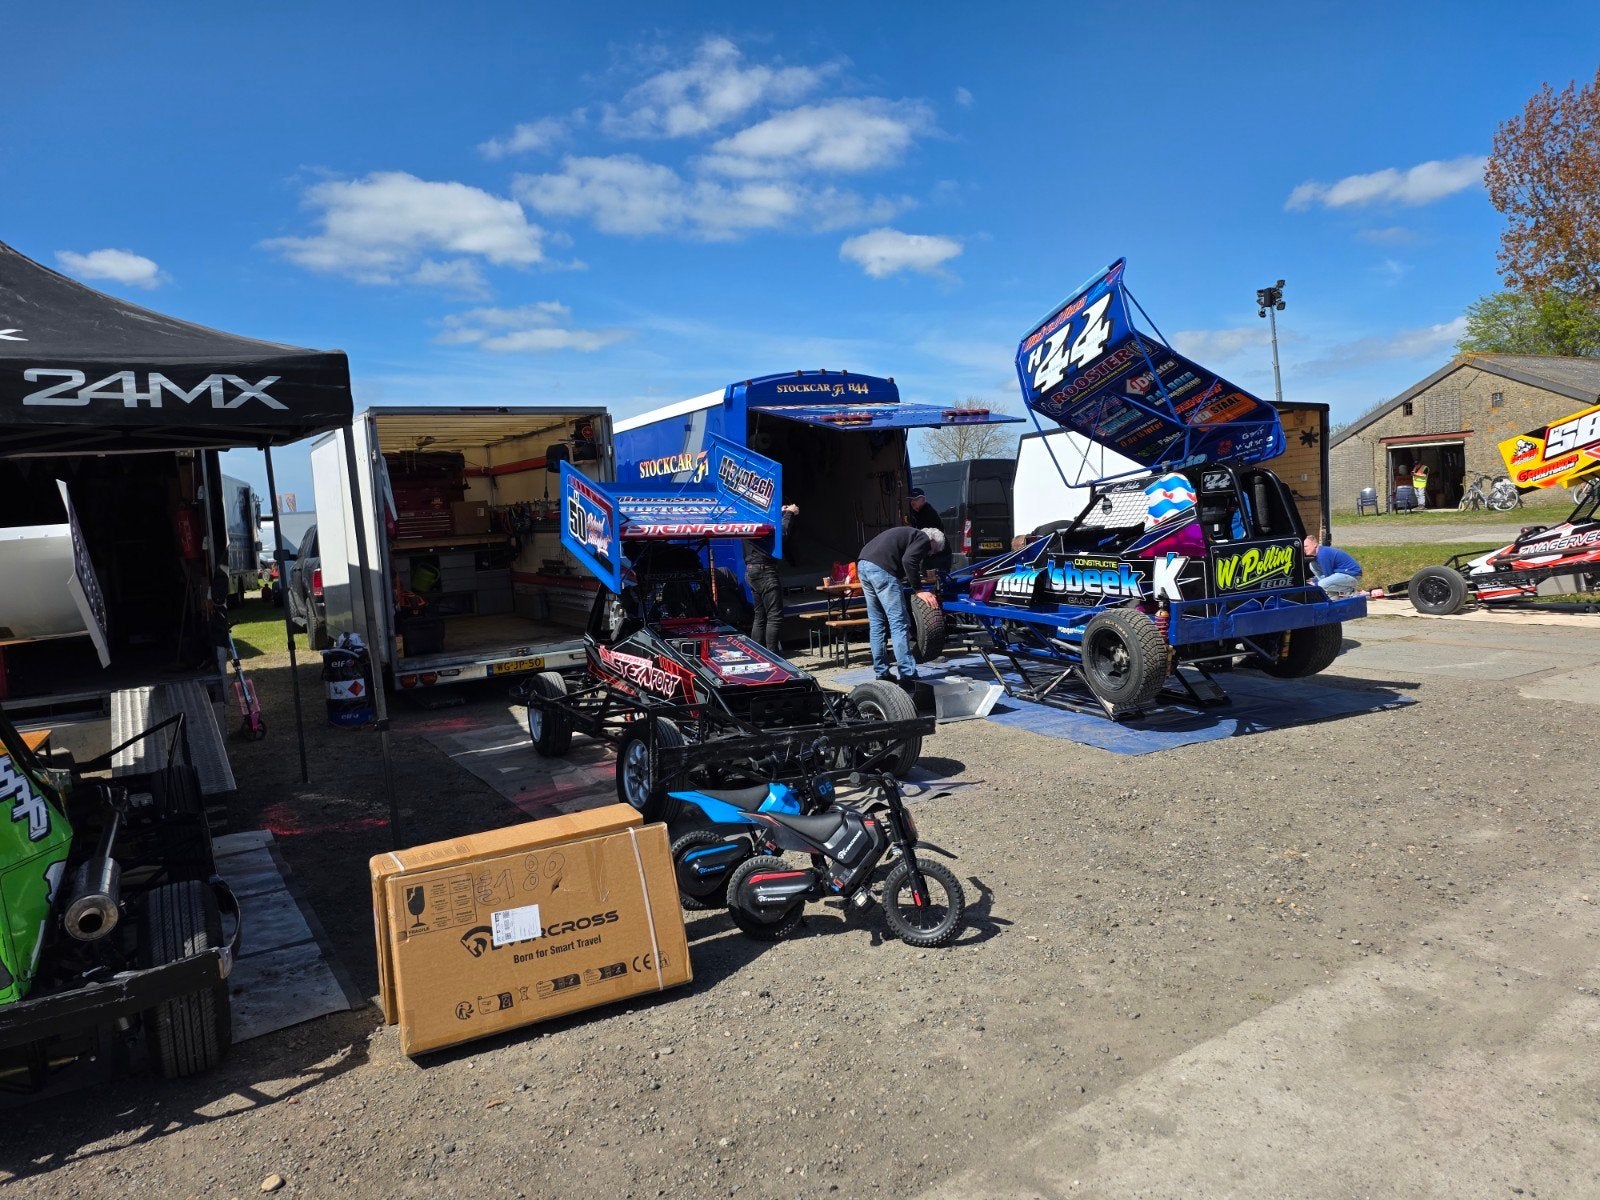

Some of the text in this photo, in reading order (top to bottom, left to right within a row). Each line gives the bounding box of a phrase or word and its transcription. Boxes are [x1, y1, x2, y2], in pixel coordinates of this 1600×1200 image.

[1051, 348, 1134, 405] ROOSTER
[23, 367, 290, 410] 24MX
[776, 383, 831, 393] STOCKCAR
[639, 452, 693, 479] STOCKCAR
[567, 496, 588, 545] 50
[624, 523, 763, 536] STEINFORT
[1154, 551, 1191, 602] K
[1260, 577, 1295, 589] EELDE
[1067, 596, 1095, 607] GAAST
[331, 659, 346, 668] elf
[408, 925, 431, 936] FRAGILE
[513, 934, 602, 964] Born for Smart Travel
